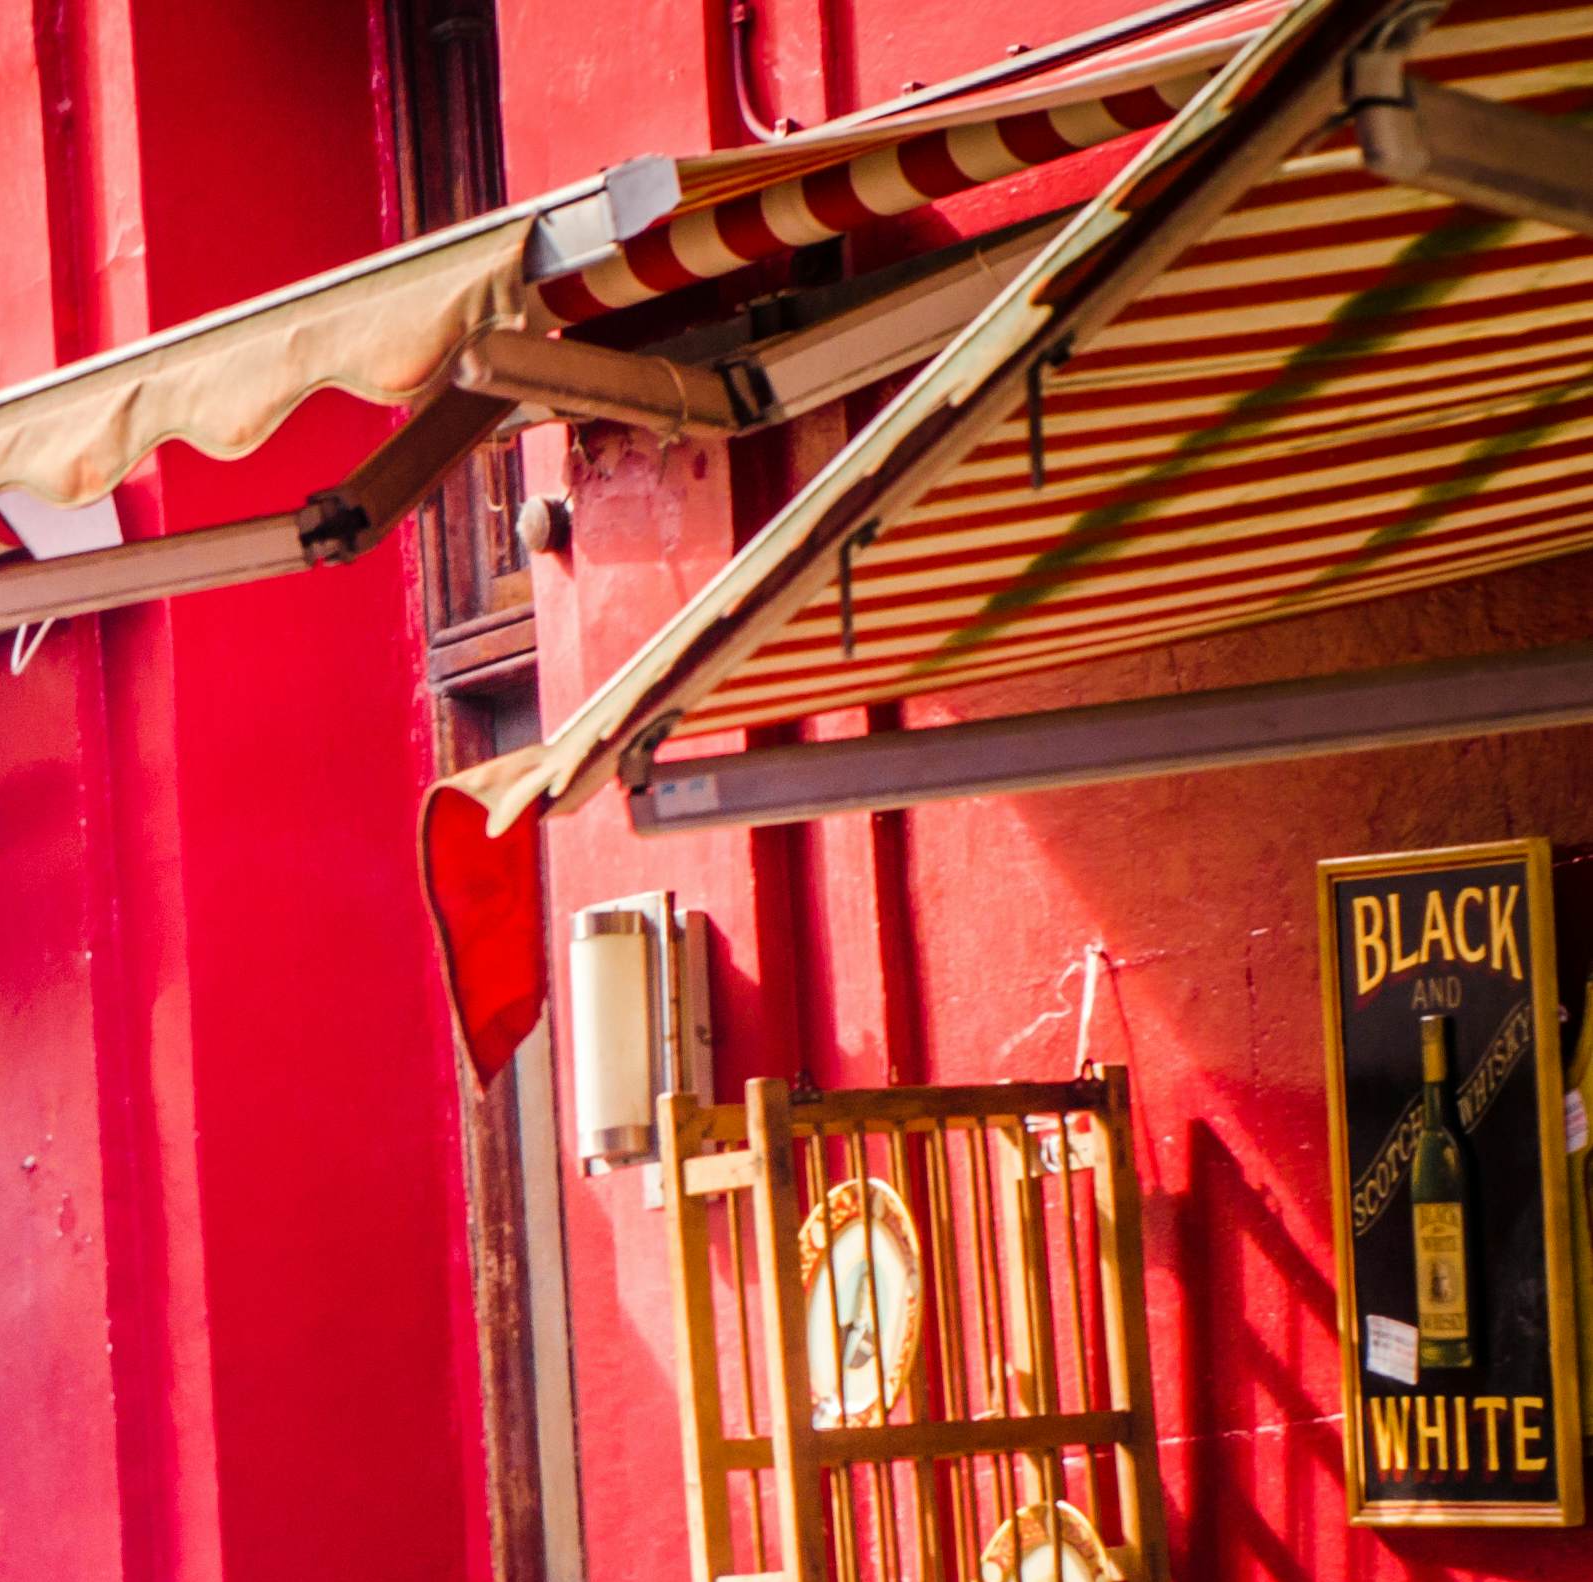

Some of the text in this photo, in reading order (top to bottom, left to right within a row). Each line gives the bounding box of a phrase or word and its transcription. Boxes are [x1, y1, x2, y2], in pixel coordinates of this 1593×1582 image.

[1352, 884, 1523, 995] BLACK
[1411, 976, 1462, 1010] AND
[1353, 1104, 1423, 1228] SCOTC
[1370, 1396, 1548, 1474] WHITE
